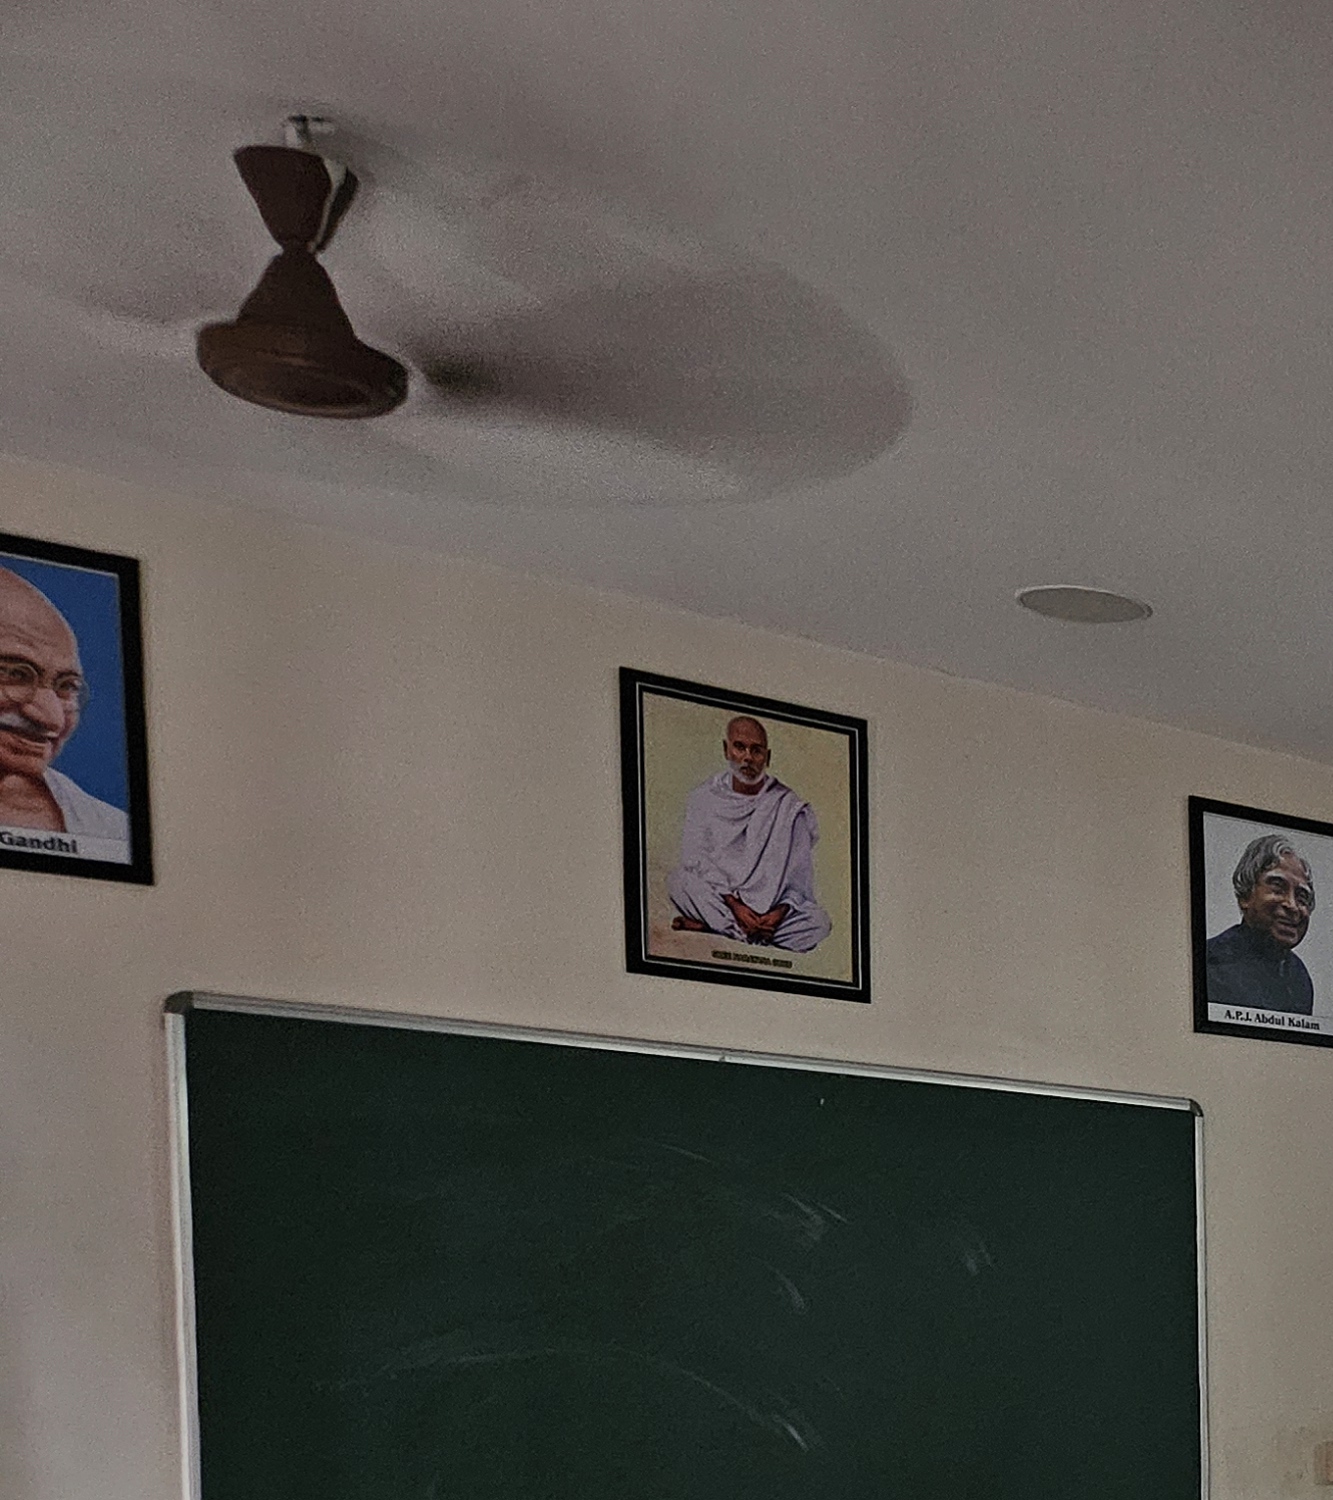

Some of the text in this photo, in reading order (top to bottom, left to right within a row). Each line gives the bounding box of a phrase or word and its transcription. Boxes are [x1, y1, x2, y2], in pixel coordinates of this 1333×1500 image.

[0, 831, 78, 855] Gandhi
[1254, 1012, 1286, 1027] Abdul
[1288, 1017, 1320, 1031] Kalam
